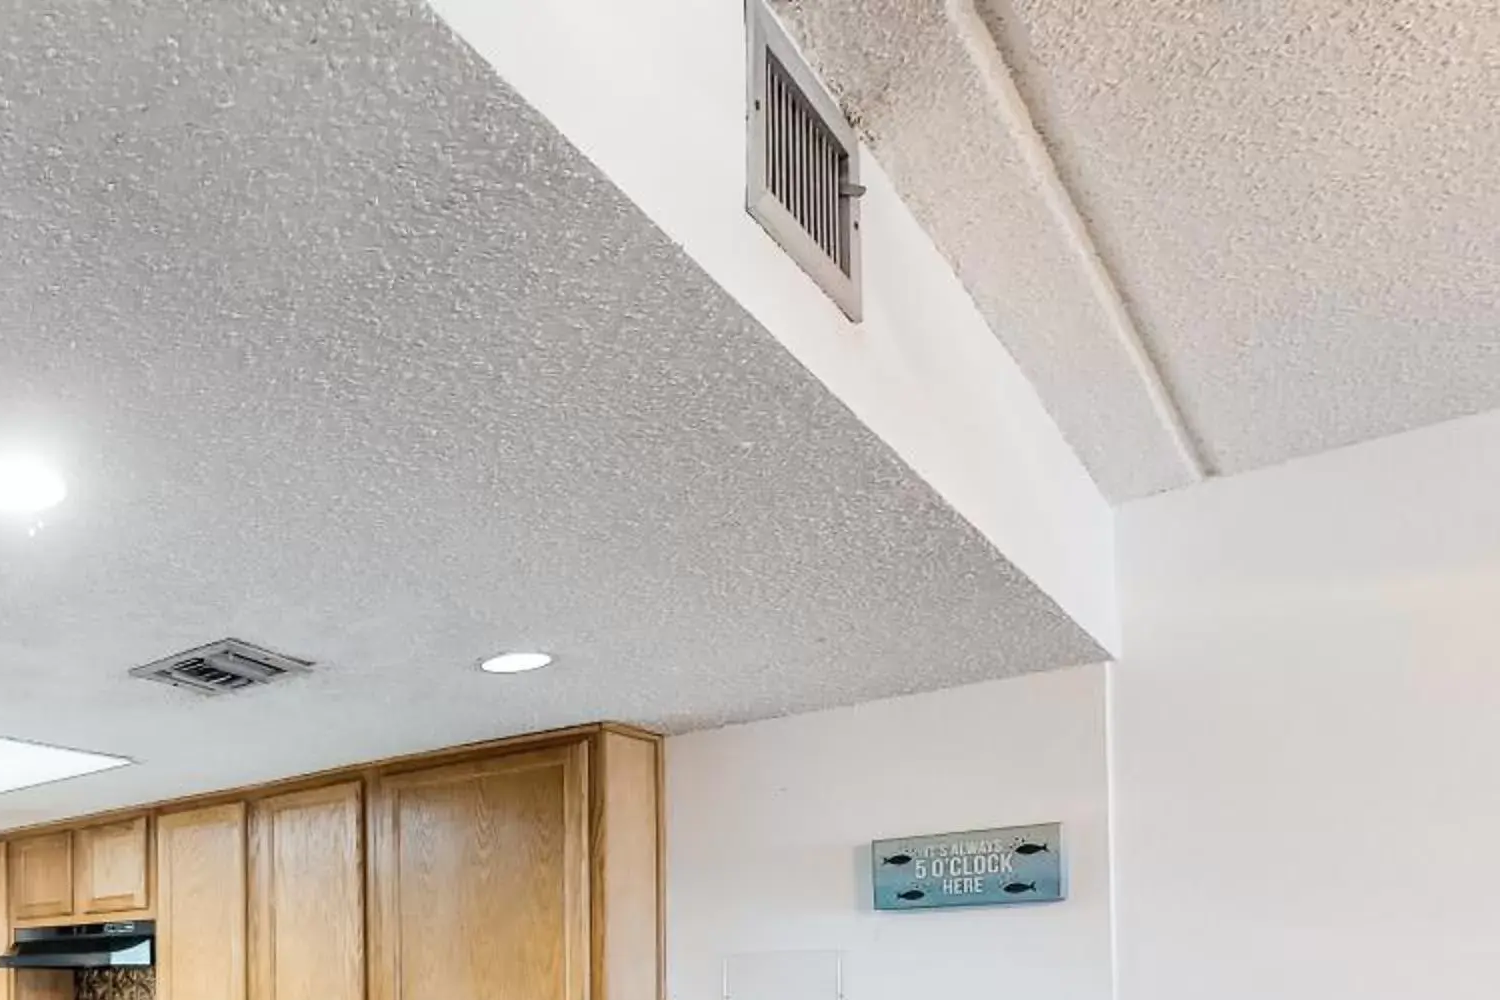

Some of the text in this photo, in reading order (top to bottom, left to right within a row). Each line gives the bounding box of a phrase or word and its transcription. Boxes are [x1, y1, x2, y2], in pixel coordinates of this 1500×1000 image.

[950, 839, 1003, 857] ALWAYS
[914, 852, 1013, 880] 5 O'CLOCK
[943, 877, 984, 895] HERE
